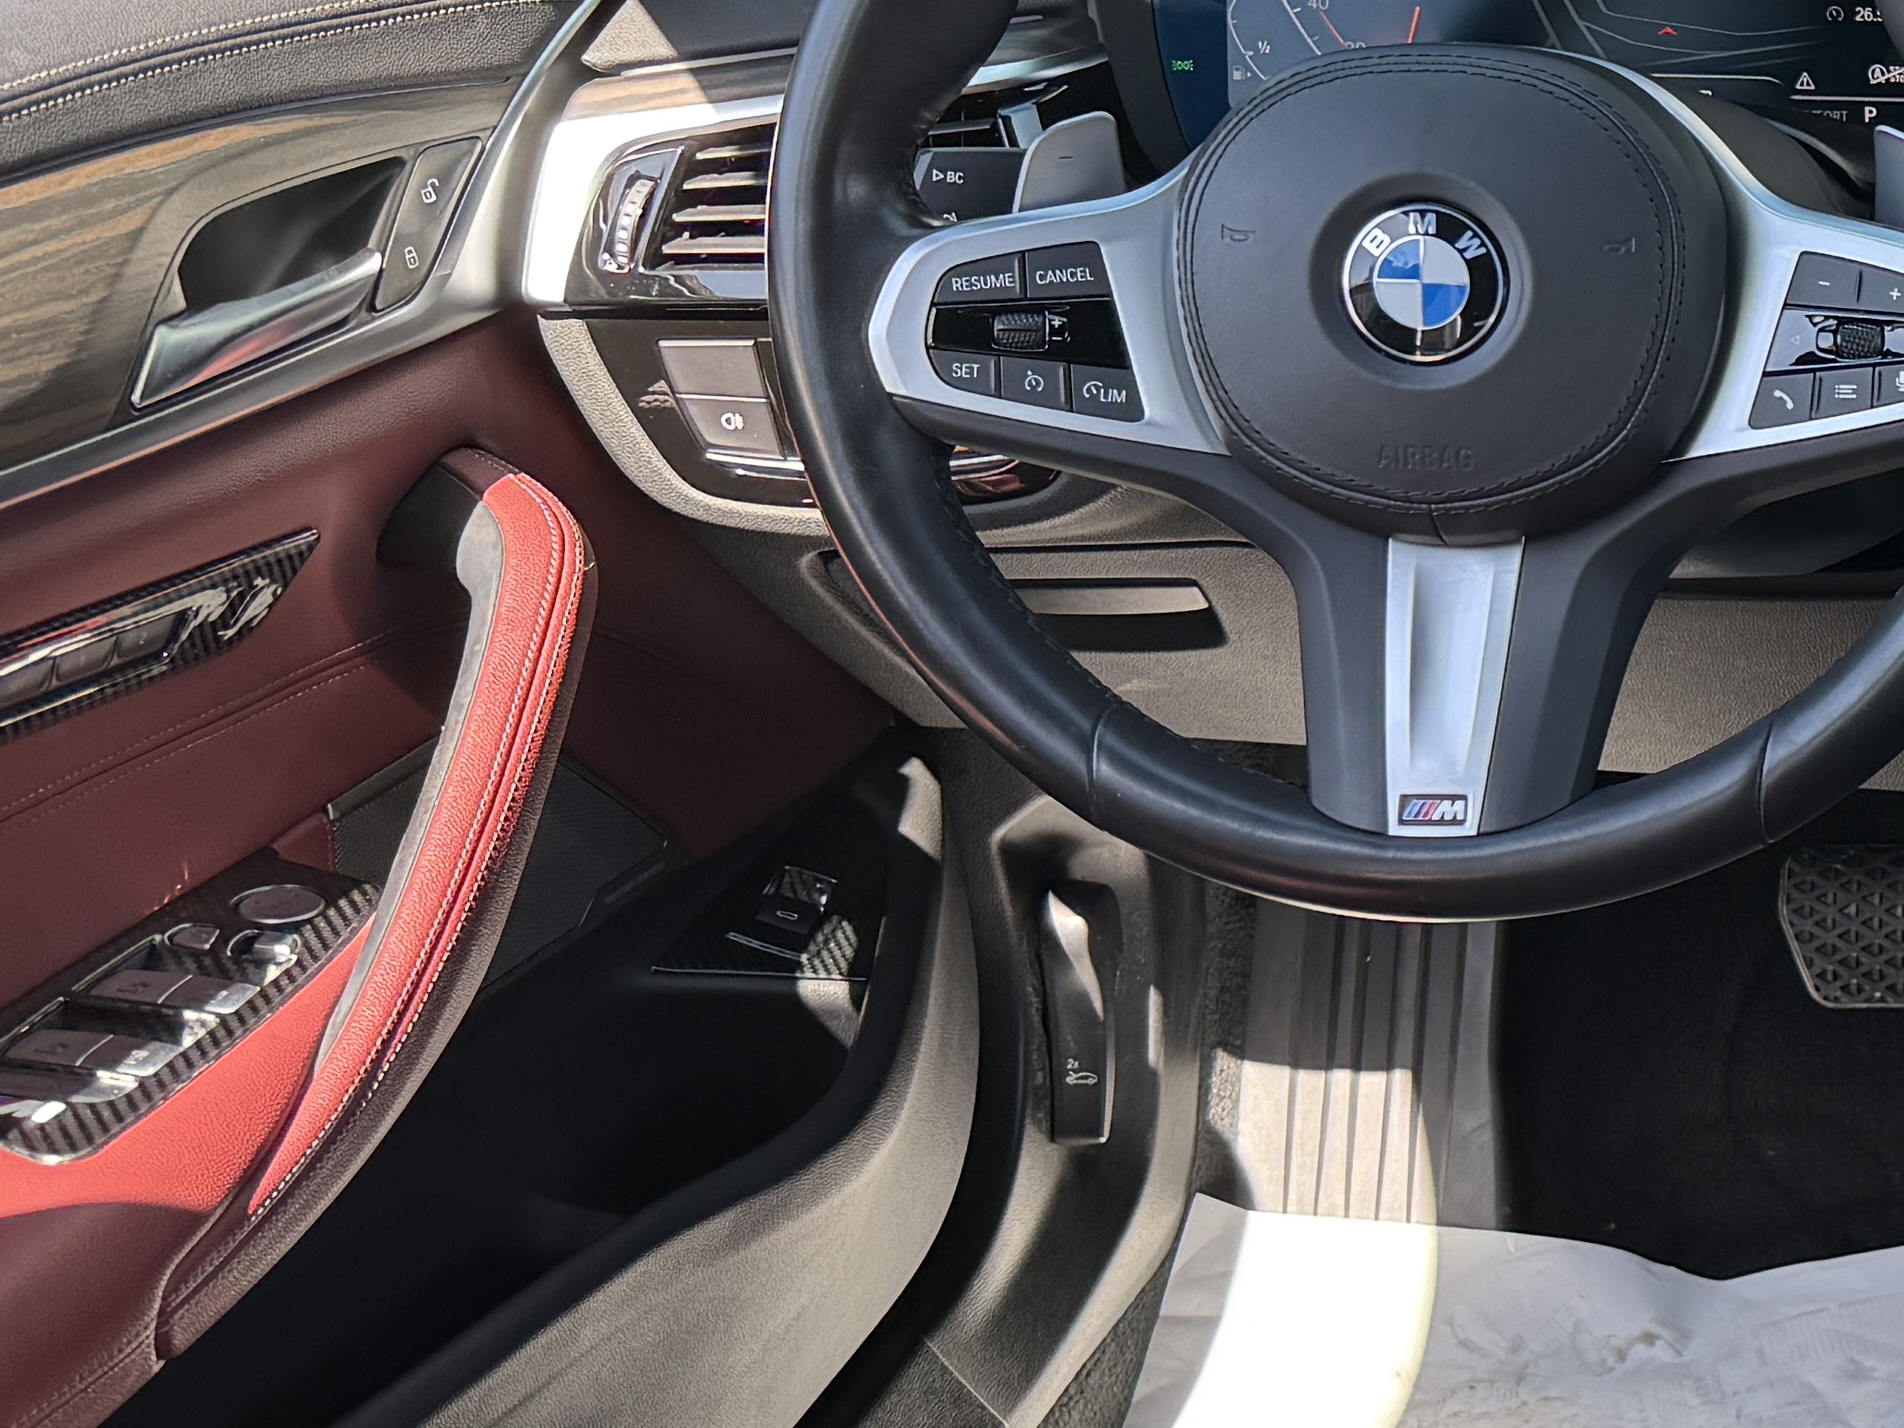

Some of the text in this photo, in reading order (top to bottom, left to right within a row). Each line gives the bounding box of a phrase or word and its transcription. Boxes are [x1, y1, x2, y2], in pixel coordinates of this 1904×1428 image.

[1864, 106, 1878, 123] P
[946, 171, 964, 185] BC
[1361, 212, 1487, 261] BMW
[952, 267, 1094, 292] RESUME CANCEL
[952, 363, 981, 379] SET
[1100, 388, 1126, 404] LIM
